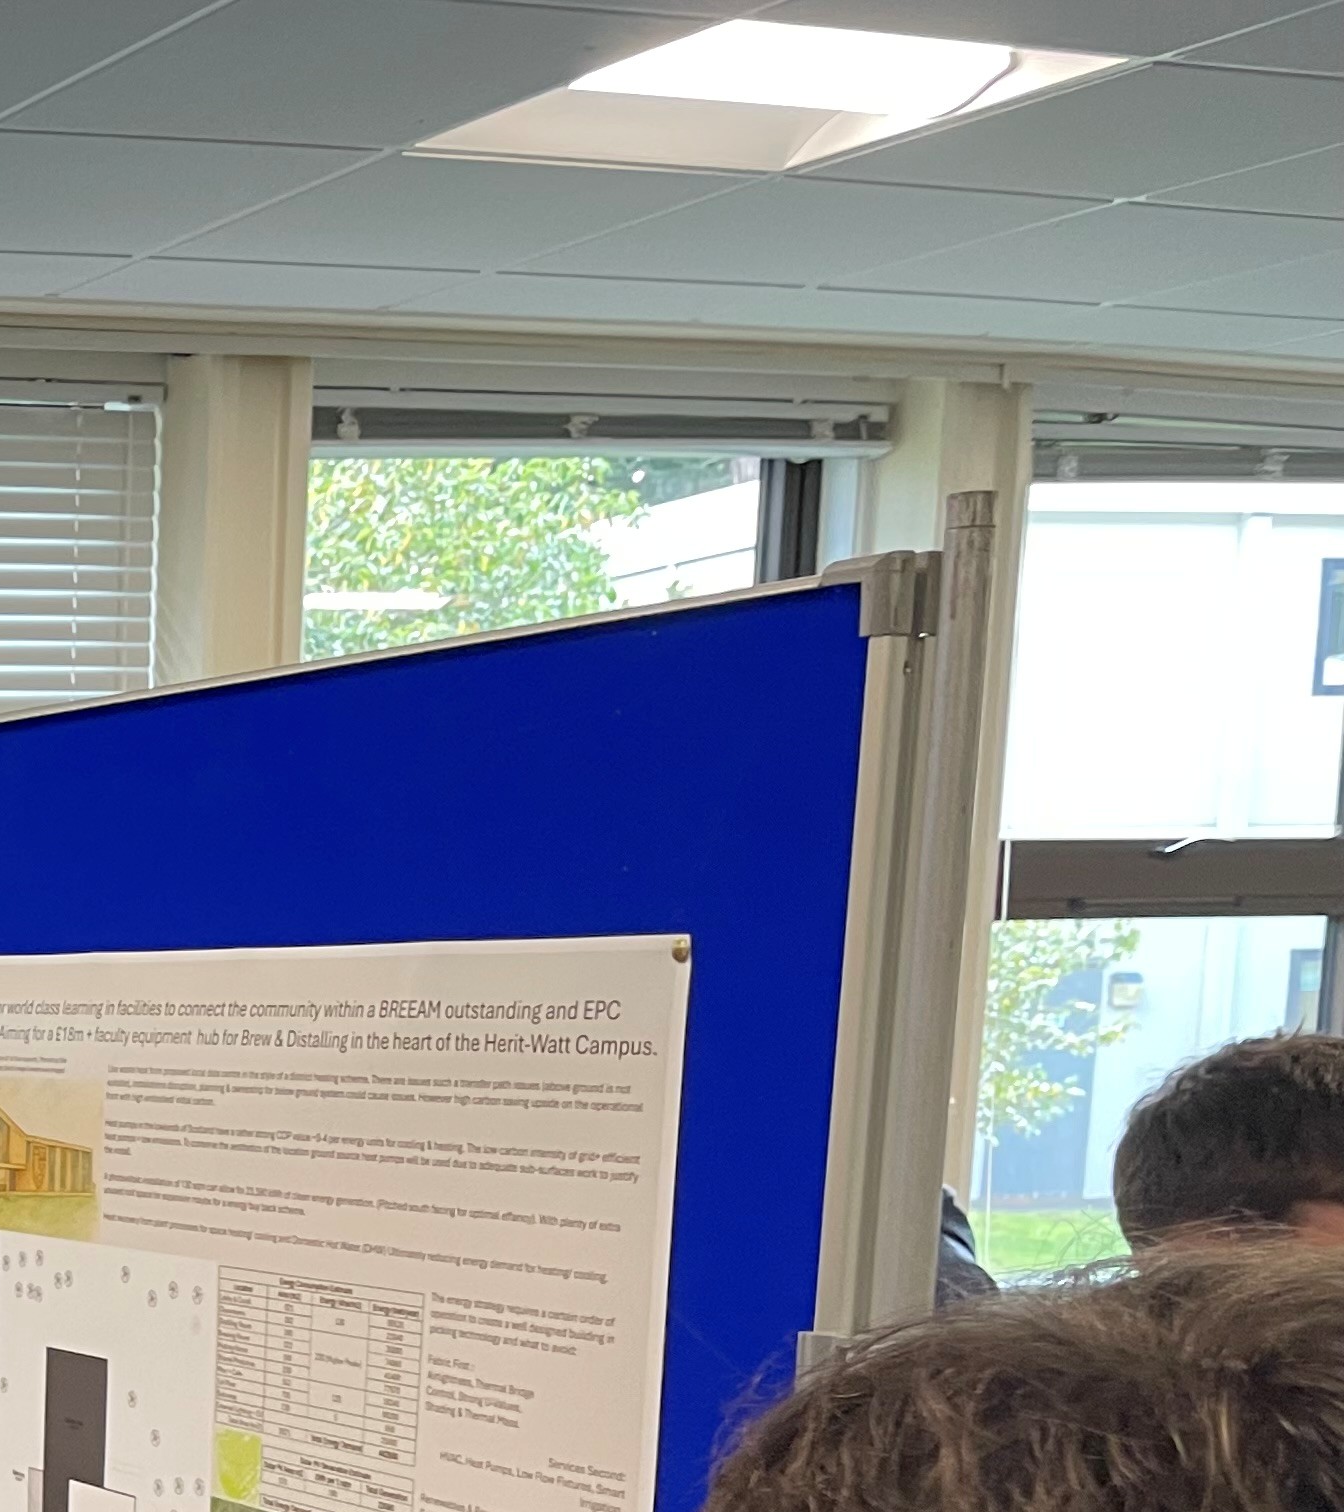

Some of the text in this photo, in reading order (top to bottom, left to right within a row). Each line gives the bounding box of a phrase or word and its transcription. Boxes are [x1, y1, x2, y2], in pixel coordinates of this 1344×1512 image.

[35, 1001, 60, 1016] class
[117, 1000, 162, 1017] facilities
[164, 1001, 176, 1017] to
[178, 1001, 227, 1018] connect
[228, 1000, 248, 1018] the
[249, 1002, 321, 1022] community
[324, 1001, 364, 1019] within
[367, 1004, 375, 1019] a
[379, 999, 441, 1019] BREEAM
[445, 1000, 543, 1025] outstanding
[545, 1000, 579, 1020] and
[583, 999, 621, 1020] EPC
[32, 1025, 45, 1041] for
[47, 1028, 54, 1041] a
[55, 1025, 84, 1042] £18m
[95, 1026, 131, 1046] faculty
[132, 1029, 192, 1048] equipment
[196, 1029, 220, 1047] hub
[222, 1029, 239, 1046] for
[241, 1029, 273, 1047] Brew
[274, 1030, 283, 1047] &
[287, 1029, 348, 1053] Distalling
[351, 1031, 363, 1049] in
[367, 1031, 390, 1050] the
[393, 1032, 432, 1051] heart
[435, 1032, 452, 1052] of
[455, 1033, 480, 1052] the
[484, 1033, 572, 1056] Herit-Watt
[575, 1034, 658, 1061] Campus.
